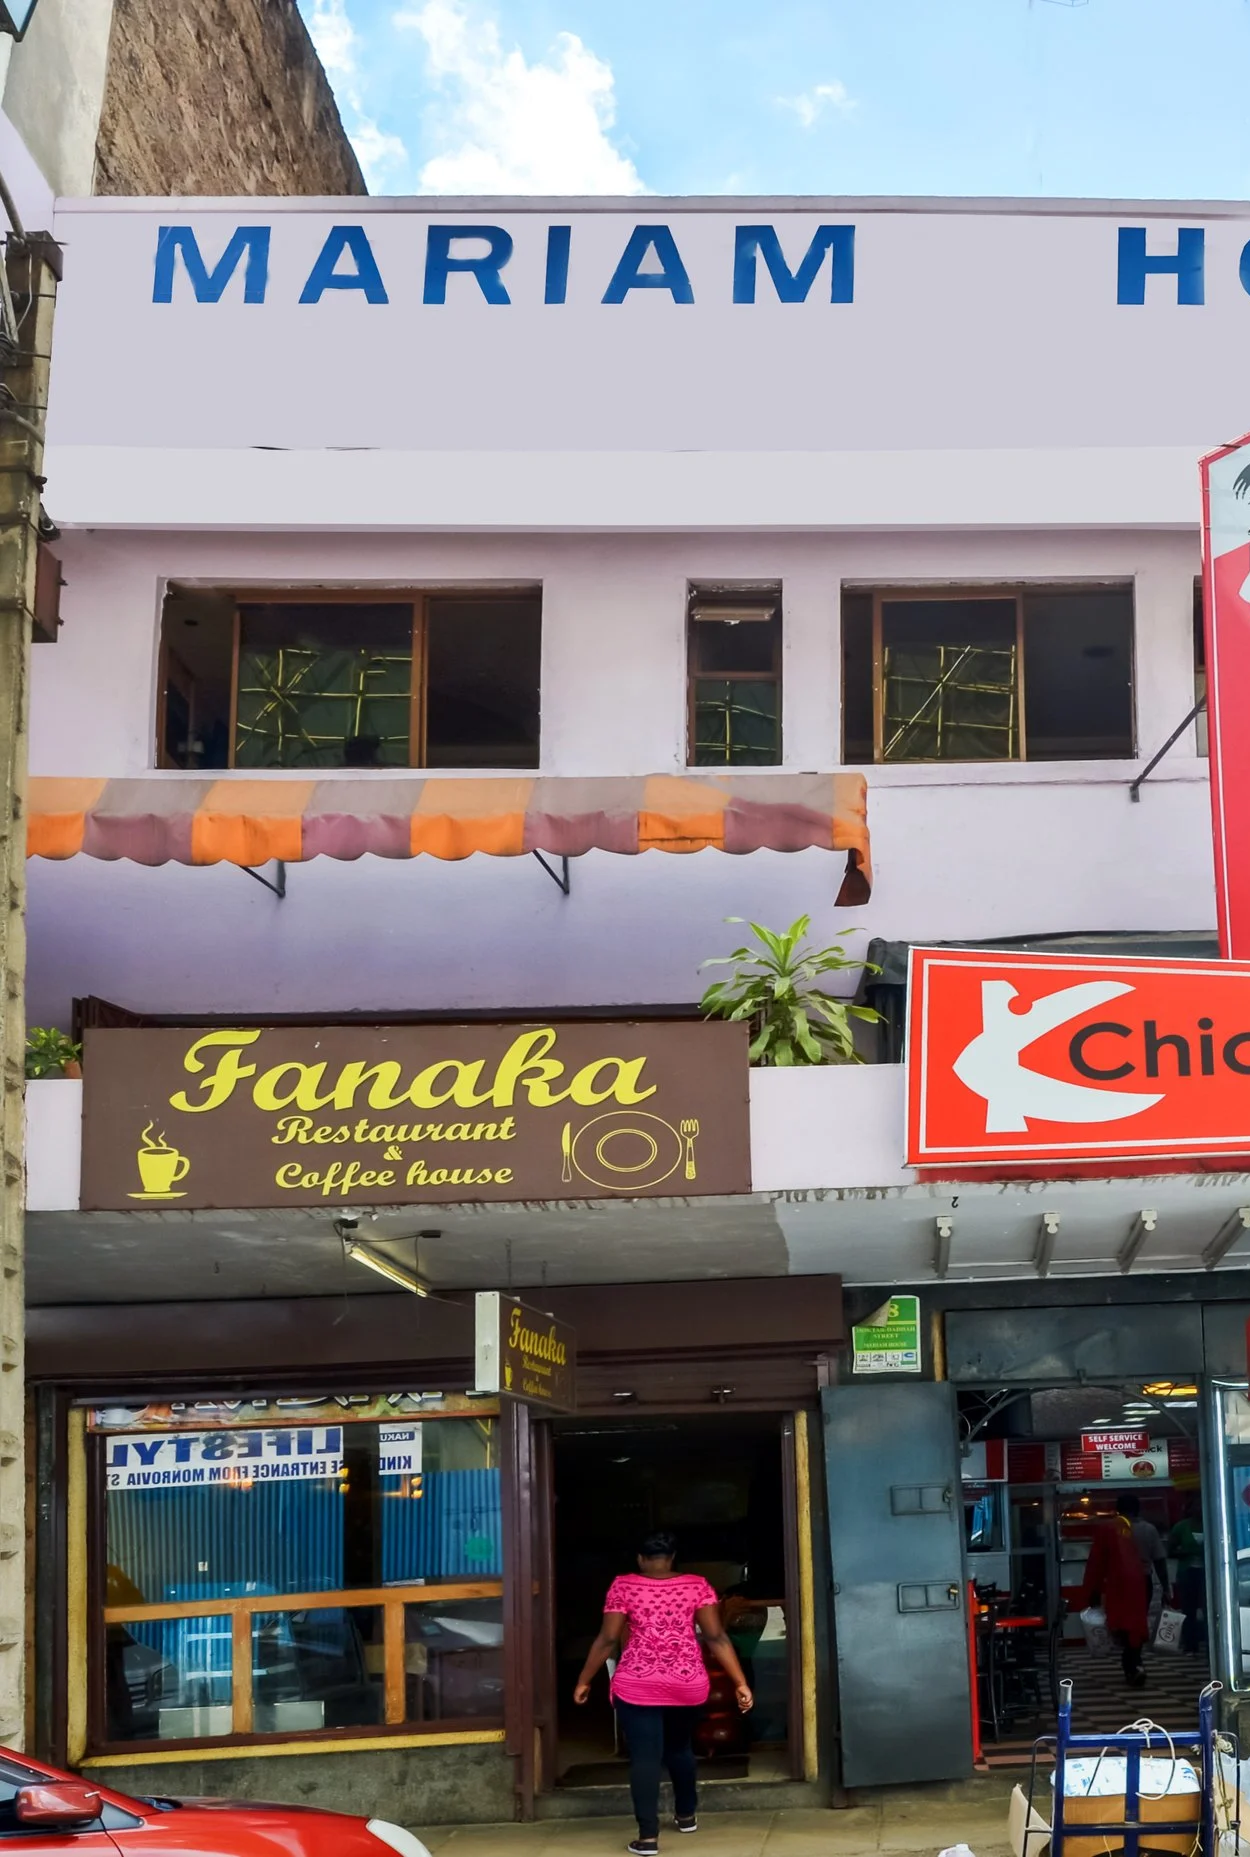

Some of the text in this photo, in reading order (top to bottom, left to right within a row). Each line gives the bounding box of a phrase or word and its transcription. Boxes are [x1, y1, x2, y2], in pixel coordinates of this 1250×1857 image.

[152, 224, 856, 305] MARIAM
[170, 1028, 657, 1113] Fanaka
[271, 1116, 516, 1145] Restaurant
[383, 1145, 403, 1161] &
[275, 1160, 513, 1196] Coffee house
[509, 1307, 566, 1366] Fanaka
[1095, 1442, 1137, 1451] WELCOME
[1108, 1433, 1143, 1442] SERVICE
